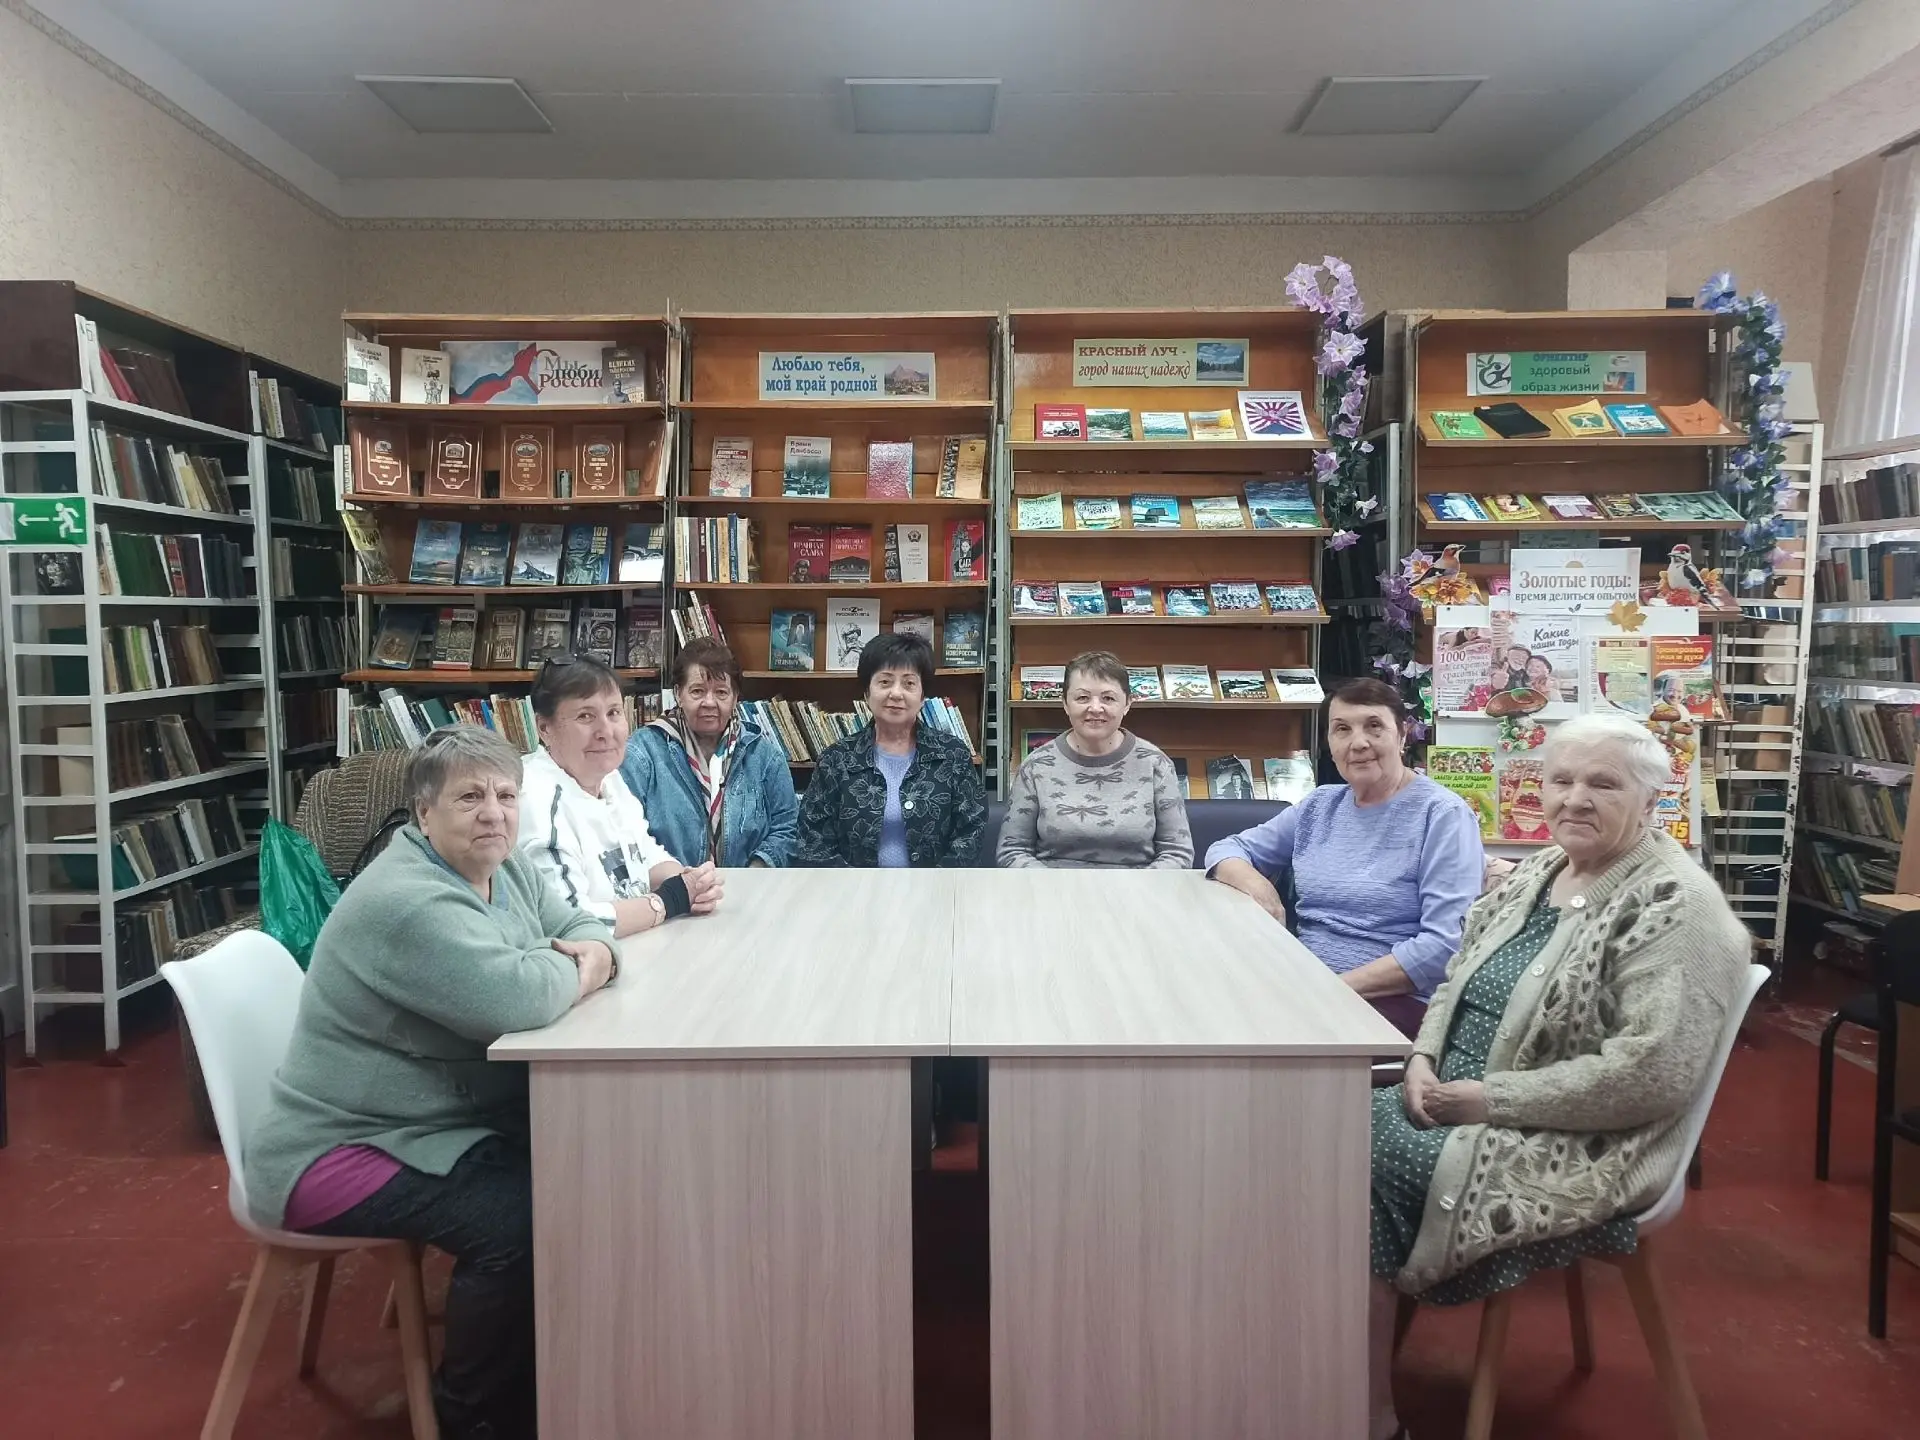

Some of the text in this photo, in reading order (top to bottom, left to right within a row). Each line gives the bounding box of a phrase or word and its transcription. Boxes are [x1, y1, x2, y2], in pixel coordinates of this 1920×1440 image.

[1079, 344, 1147, 357] КРАСНЫЙ
[1151, 347, 1178, 356] ЛУЧ
[545, 356, 578, 370] Мы
[772, 356, 865, 374] Люблю тебя,
[1078, 360, 1191, 380] город наших надежд
[550, 364, 602, 380] люби
[1530, 364, 1591, 377] здоровый
[539, 374, 602, 389] Росси
[765, 374, 877, 396] мой край родной
[1521, 382, 1600, 394] образ жизни
[1519, 571, 1632, 589] Золотые годы:
[1515, 592, 1637, 603] время делиться опытом
[1533, 628, 1570, 641] Какие
[1530, 639, 1579, 650] наши годы
[1440, 651, 1466, 663] 1000
[1671, 820, 1690, 840] 15
